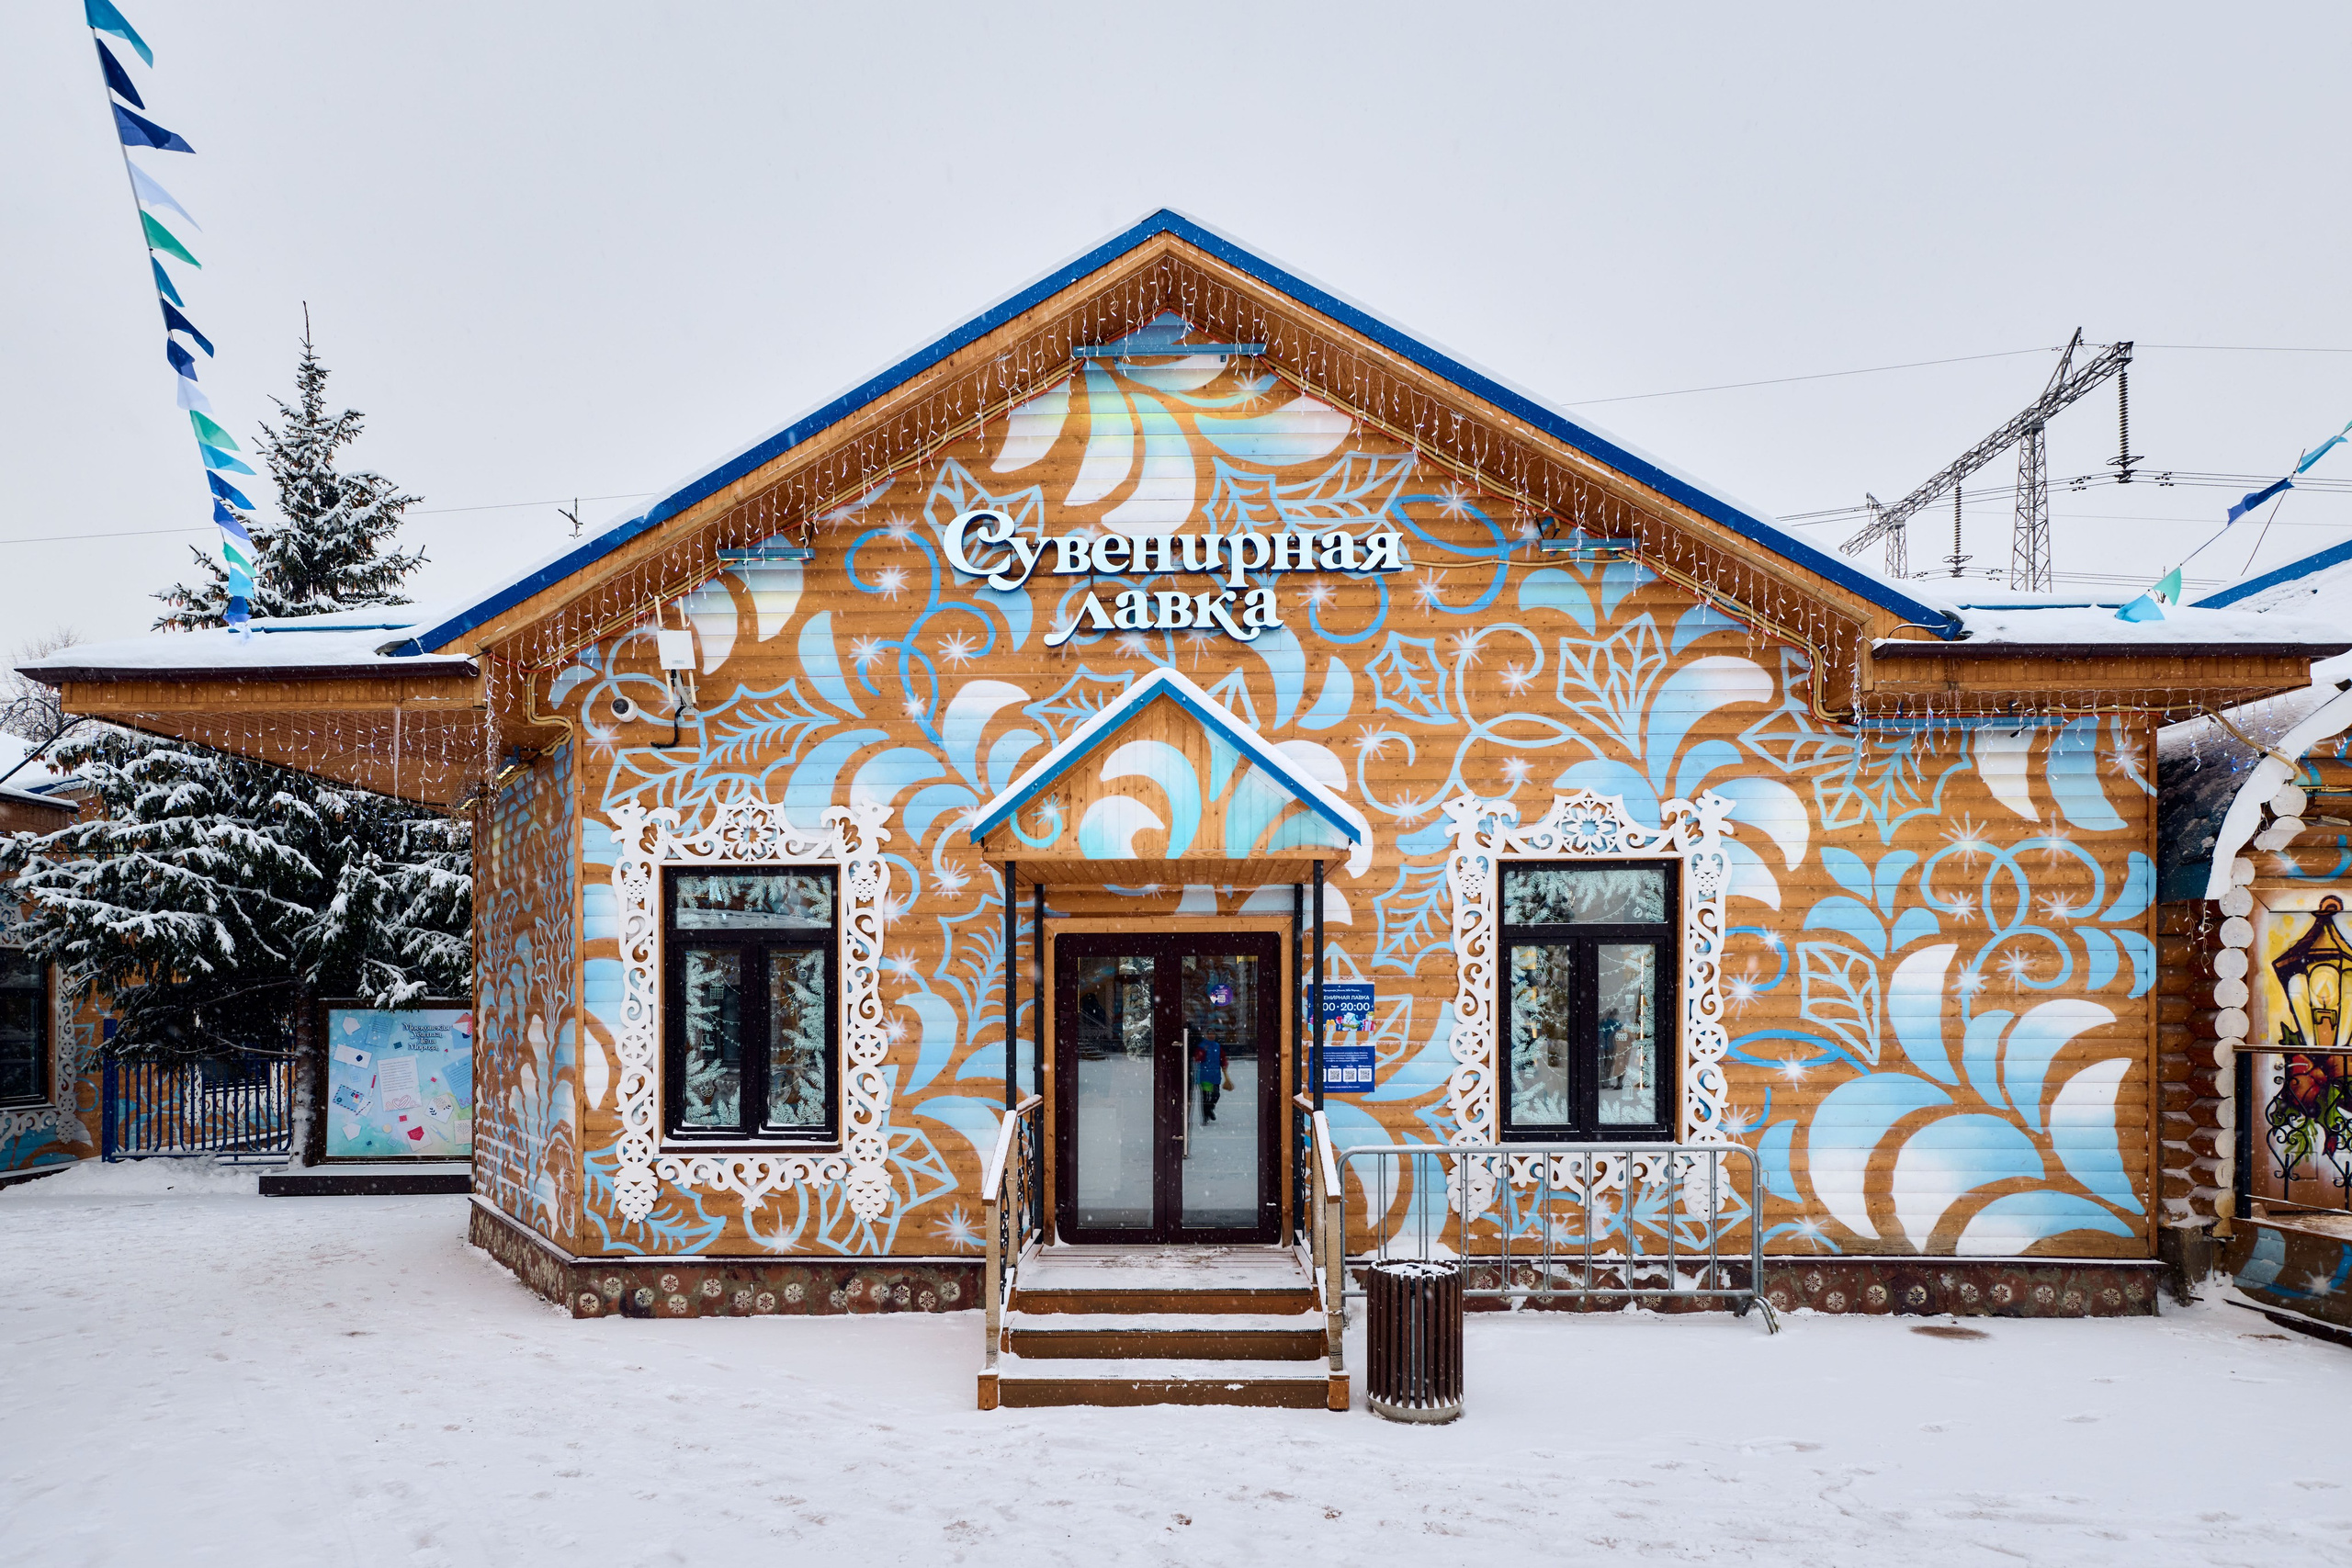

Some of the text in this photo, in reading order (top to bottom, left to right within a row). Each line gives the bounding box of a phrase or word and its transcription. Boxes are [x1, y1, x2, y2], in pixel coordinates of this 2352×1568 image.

[944, 510, 1404, 592] Сувенирная
[1044, 589, 1284, 648] лавка
[1340, 1002, 1370, 1011] 20:00
